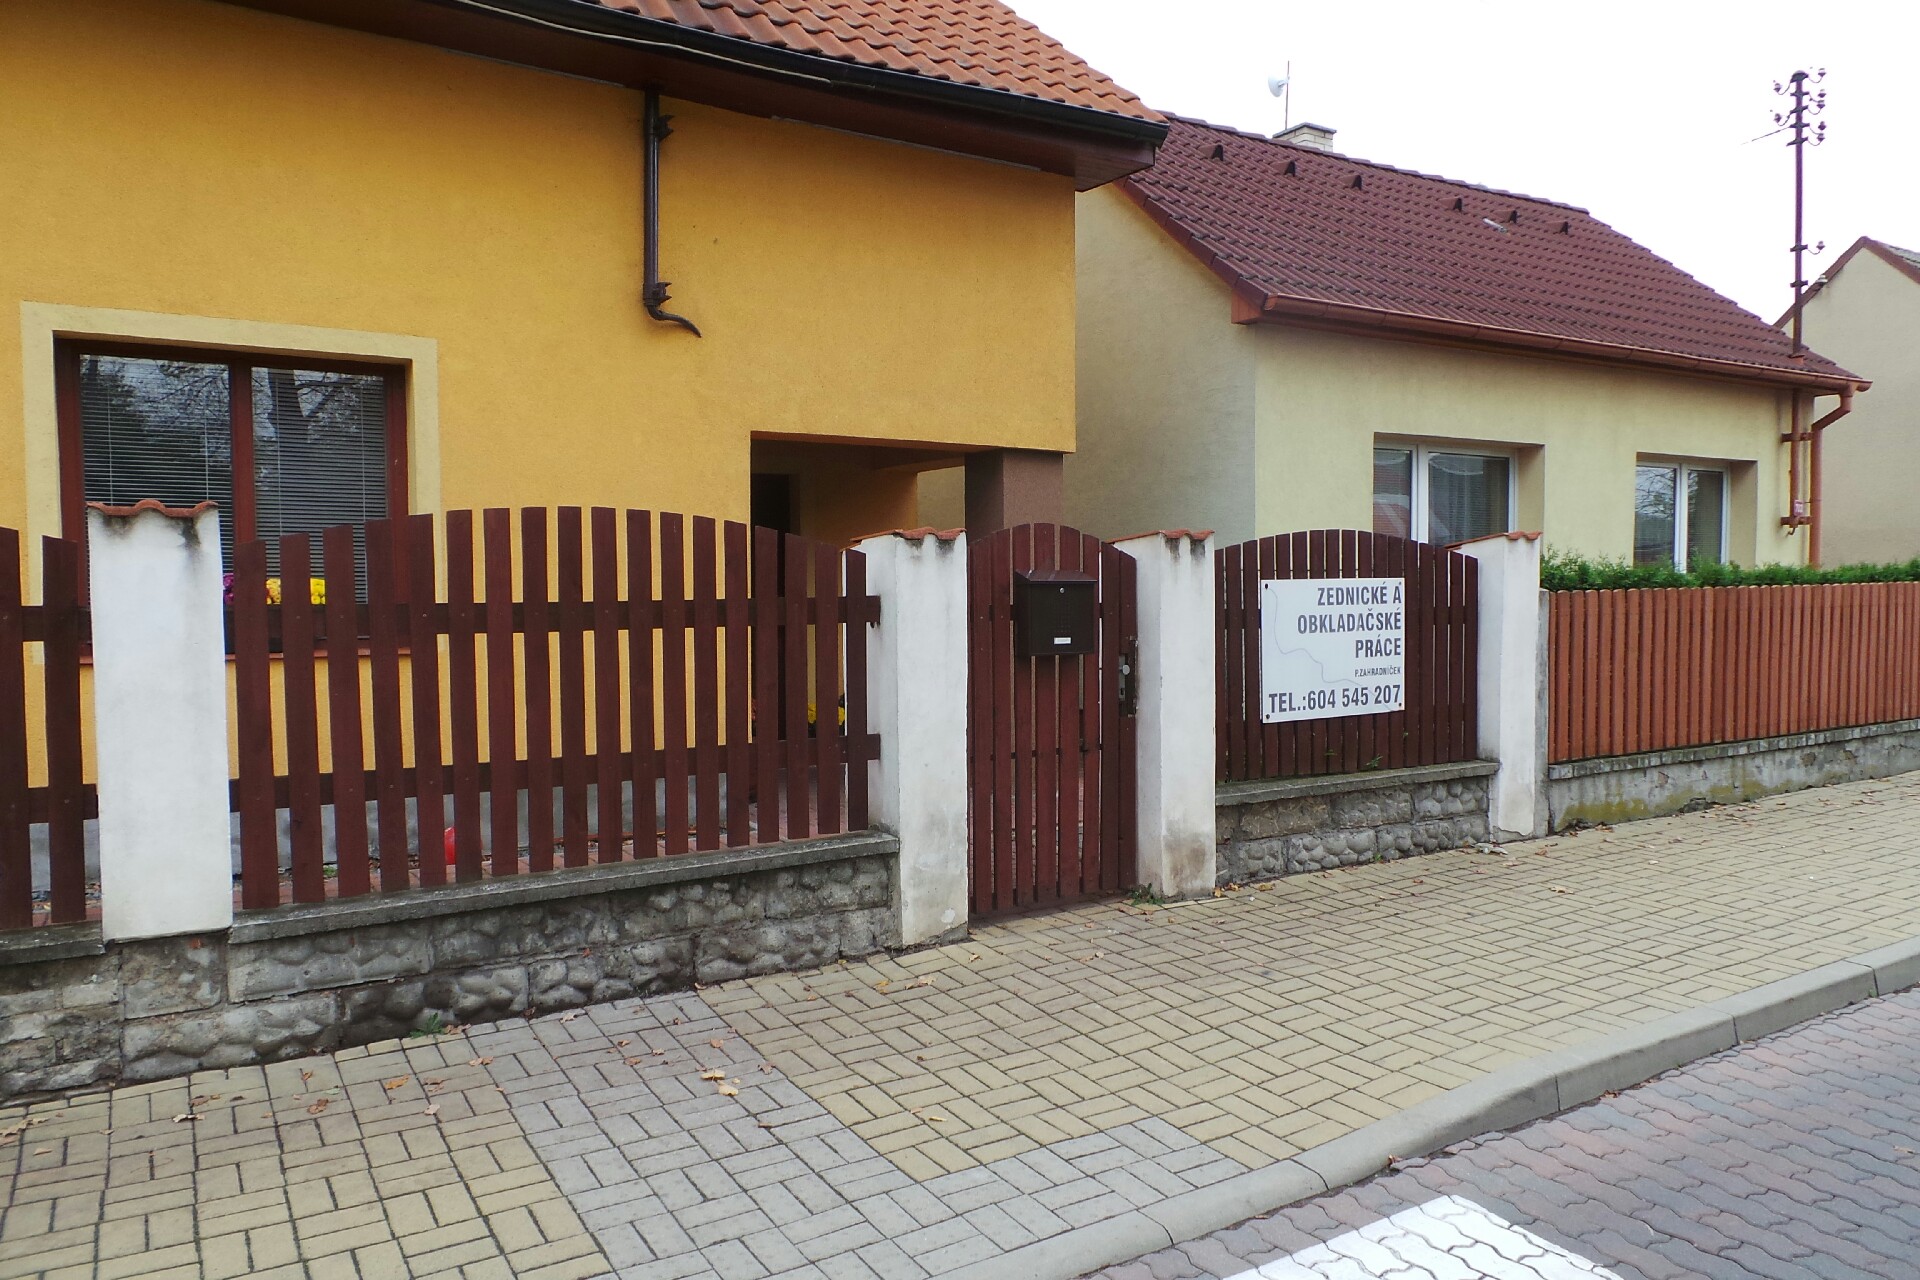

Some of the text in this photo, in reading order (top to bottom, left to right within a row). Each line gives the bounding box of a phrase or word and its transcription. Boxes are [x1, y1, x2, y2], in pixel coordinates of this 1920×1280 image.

[1318, 582, 1402, 606] ZEDNICKÉ A
[1297, 607, 1402, 634] OBKLADAČSKÉ
[1355, 634, 1401, 658] PRÁCE
[1342, 687, 1369, 707] 545
[1374, 684, 1401, 704] 207
